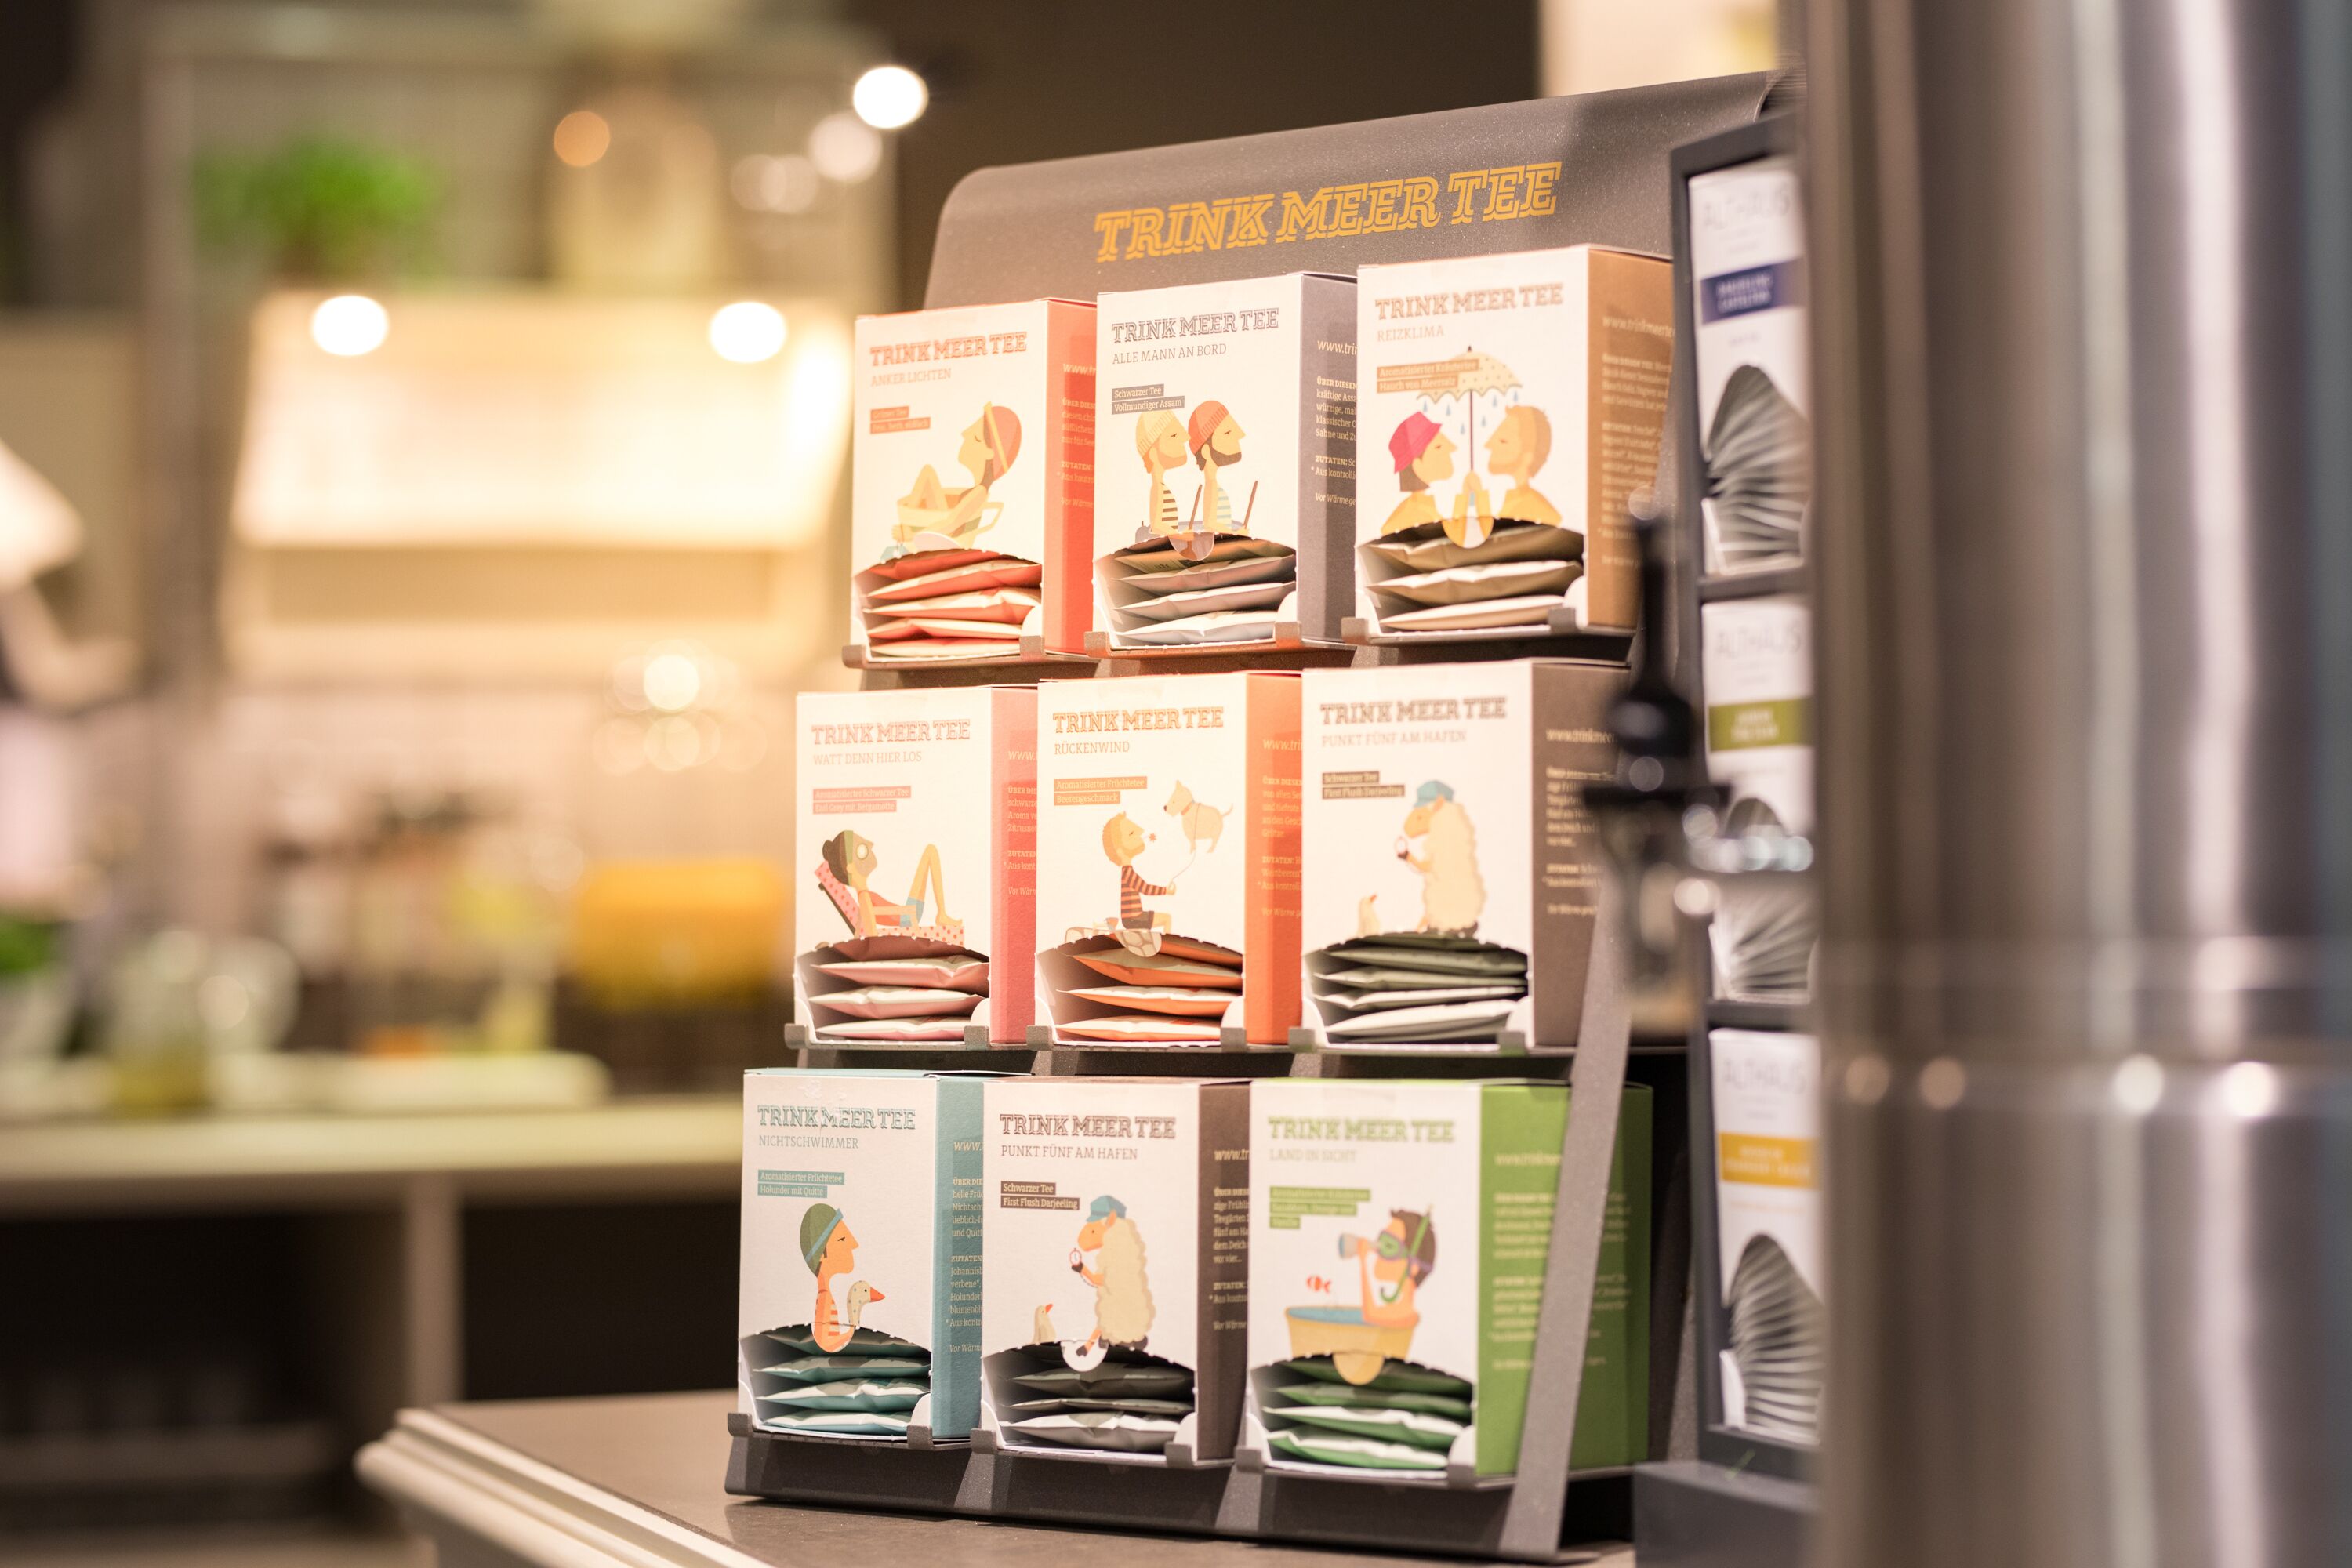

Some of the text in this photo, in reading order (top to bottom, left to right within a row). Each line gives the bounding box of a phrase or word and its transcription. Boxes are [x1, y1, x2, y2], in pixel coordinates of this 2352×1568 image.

[1094, 162, 1562, 262] TRINK MEER TEE
[1375, 282, 1563, 320] TRINK MEER TEE
[1112, 307, 1279, 343] TRINK MEER TEE
[1377, 325, 1444, 342] REIZKLIMA
[870, 332, 1027, 367] TRINK MEER TEE
[1112, 343, 1226, 364] ALLE MANN AN BORD
[870, 368, 951, 387] ANKER LICHTEN
[1317, 376, 1357, 390] ÜBER DIESEN
[1114, 389, 1148, 398] Schwarzer
[1317, 389, 1341, 401] kräftige
[1115, 399, 1181, 412] Vollmundiger Assam
[1316, 403, 1343, 415] würzige,
[1316, 416, 1351, 427] klassischer
[1316, 428, 1335, 438] Sahne
[1316, 456, 1348, 465] ZUTATEN:
[1315, 467, 1327, 476] Aus
[1316, 493, 1326, 502] Vor
[1327, 494, 1348, 503] Wärme
[1320, 697, 1506, 724] TRINK MEER TEE
[1053, 706, 1224, 733] TRINK MEER TEE
[812, 719, 971, 745] TRINK MEER TEE
[1322, 730, 1466, 747] PUNKT FÜNF AM HAFEN
[1054, 740, 1130, 754] RÜCKENWIND
[814, 751, 922, 765] WATT DENN HIER LOS
[1057, 780, 1106, 790] Aromatisierter
[897, 788, 909, 797] Tee
[1057, 793, 1117, 804] Beerengeschmack
[758, 1105, 916, 1129] TRINK MEER TEE
[1000, 1113, 1176, 1138] TRINK MEER TEE
[1269, 1116, 1454, 1142] TRINK MEER TEE
[759, 1135, 858, 1149] NICHTSCHWIMMER
[1001, 1144, 1138, 1160] PUNKT FÜNF AM HAFEN
[760, 1172, 842, 1183] Aromatisierter Früchtetee
[760, 1185, 790, 1194] Holunder
[803, 1187, 823, 1196] Quitte
[1004, 1184, 1053, 1193] Schwarzer Tee
[1004, 1198, 1077, 1210] First Flush Darjeeling
